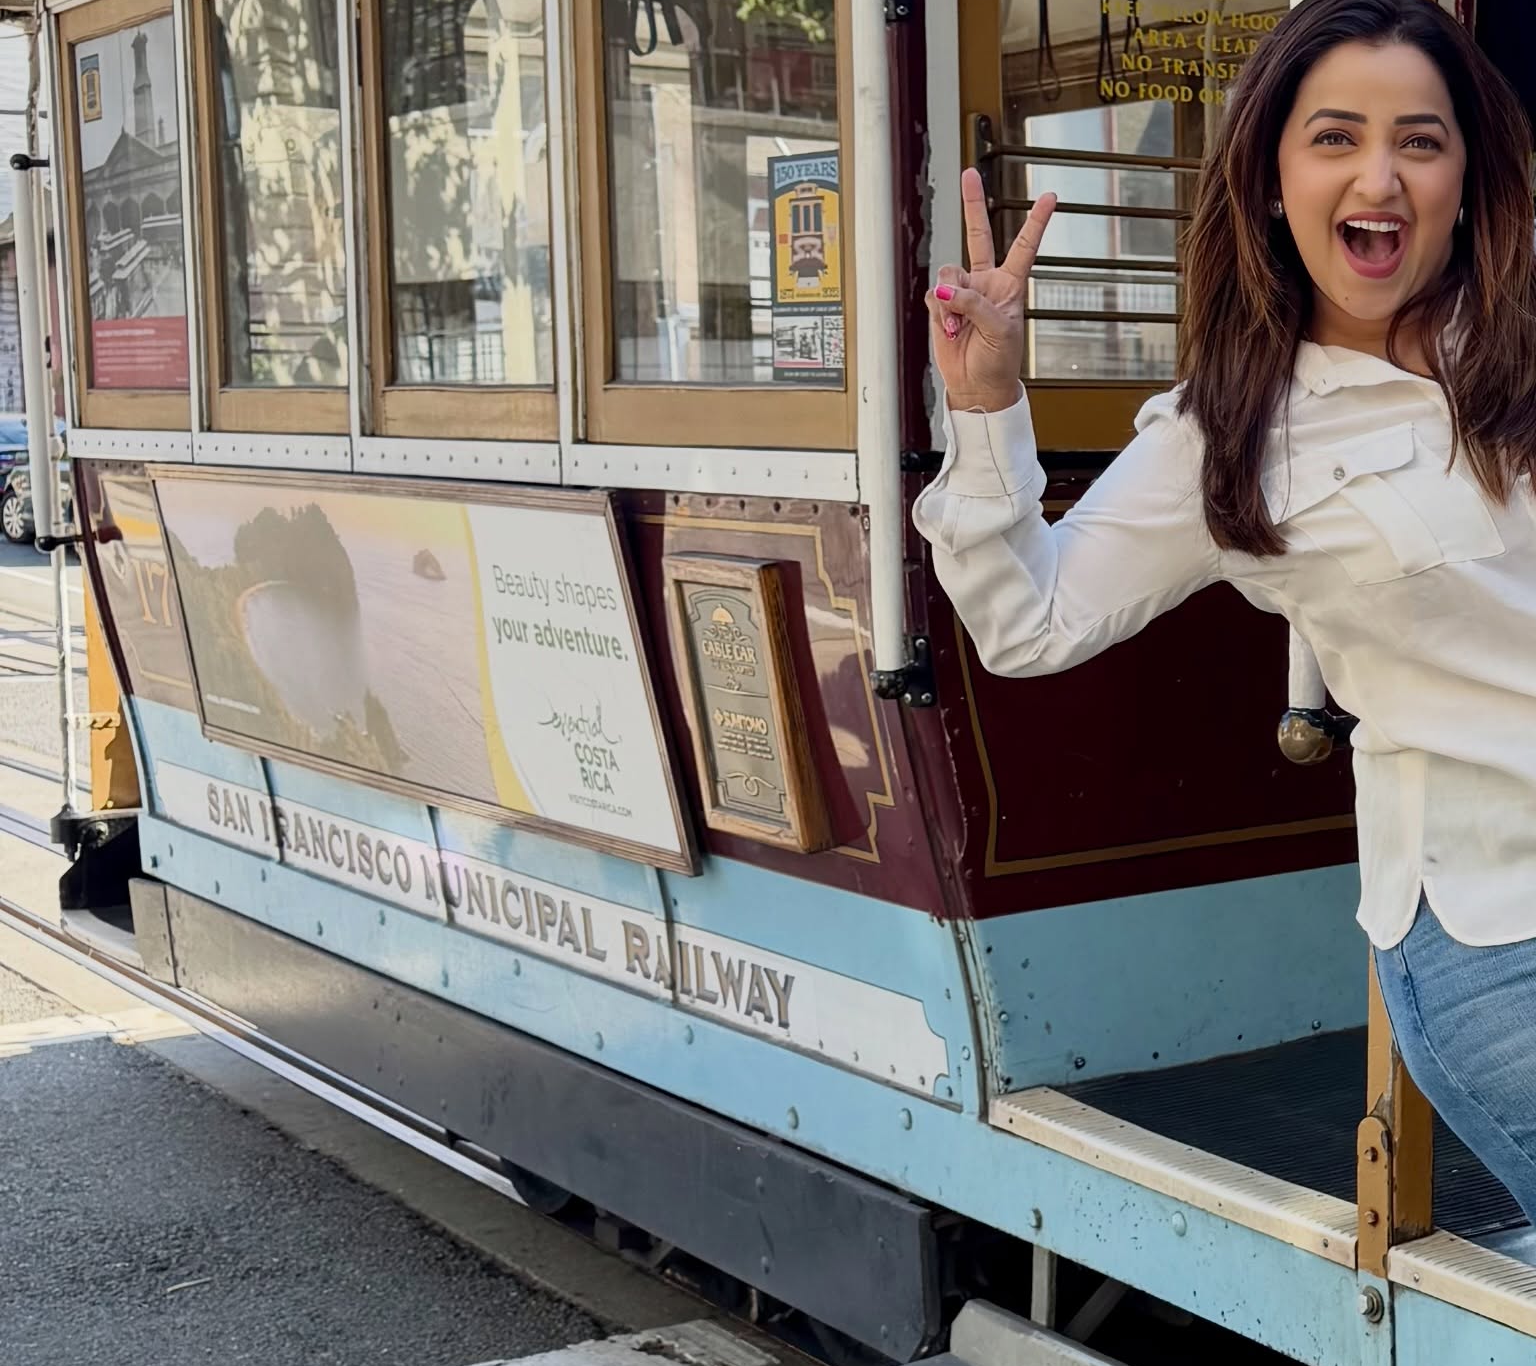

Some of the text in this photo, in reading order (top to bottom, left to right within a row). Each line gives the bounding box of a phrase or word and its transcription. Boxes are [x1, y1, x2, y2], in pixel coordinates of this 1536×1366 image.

[1231, 12, 1283, 32] FLOO
[1134, 27, 1187, 49] AREA
[1120, 53, 1243, 81] NO TRANSF
[1100, 79, 1131, 99] NO
[1138, 83, 1193, 103] FOOD
[775, 160, 837, 184] 150 YEARS
[130, 559, 173, 628] 17
[492, 564, 618, 614] Beauty shapes
[492, 614, 630, 662] your adventure.
[702, 638, 758, 666] CABLE CAR
[574, 742, 621, 772] COSTA
[579, 766, 616, 796] RICA
[207, 782, 255, 836] SAN
[621, 919, 796, 1030] RAILWAY
